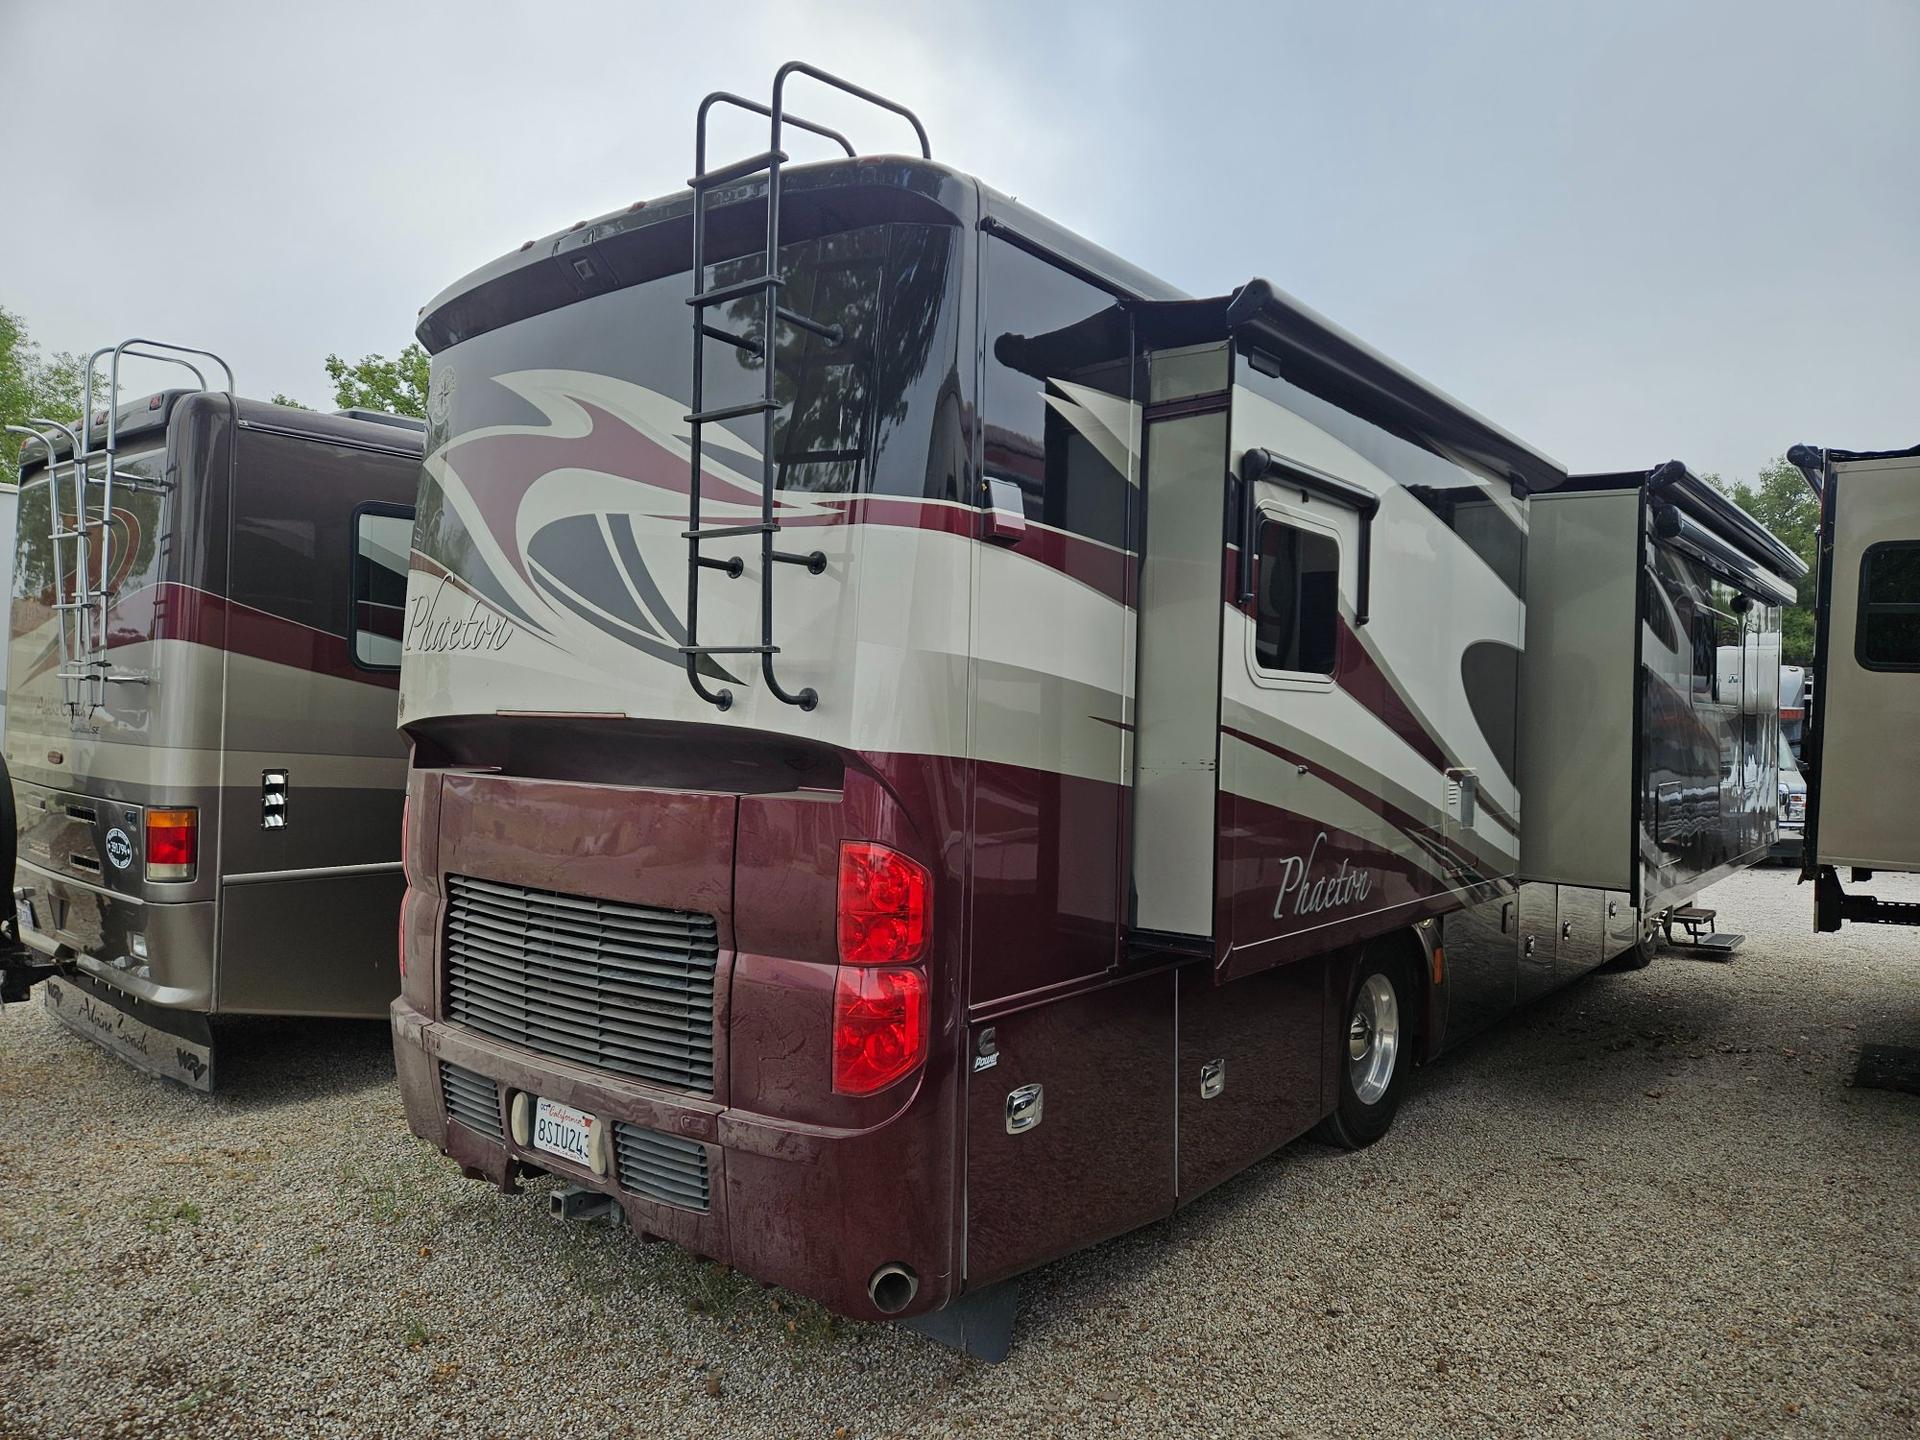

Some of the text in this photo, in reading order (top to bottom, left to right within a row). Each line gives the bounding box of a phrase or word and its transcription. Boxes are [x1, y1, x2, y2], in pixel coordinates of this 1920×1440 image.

[405, 572, 514, 653] Phaeton
[1273, 831, 1373, 919] Phaeton
[549, 1106, 582, 1124] California
